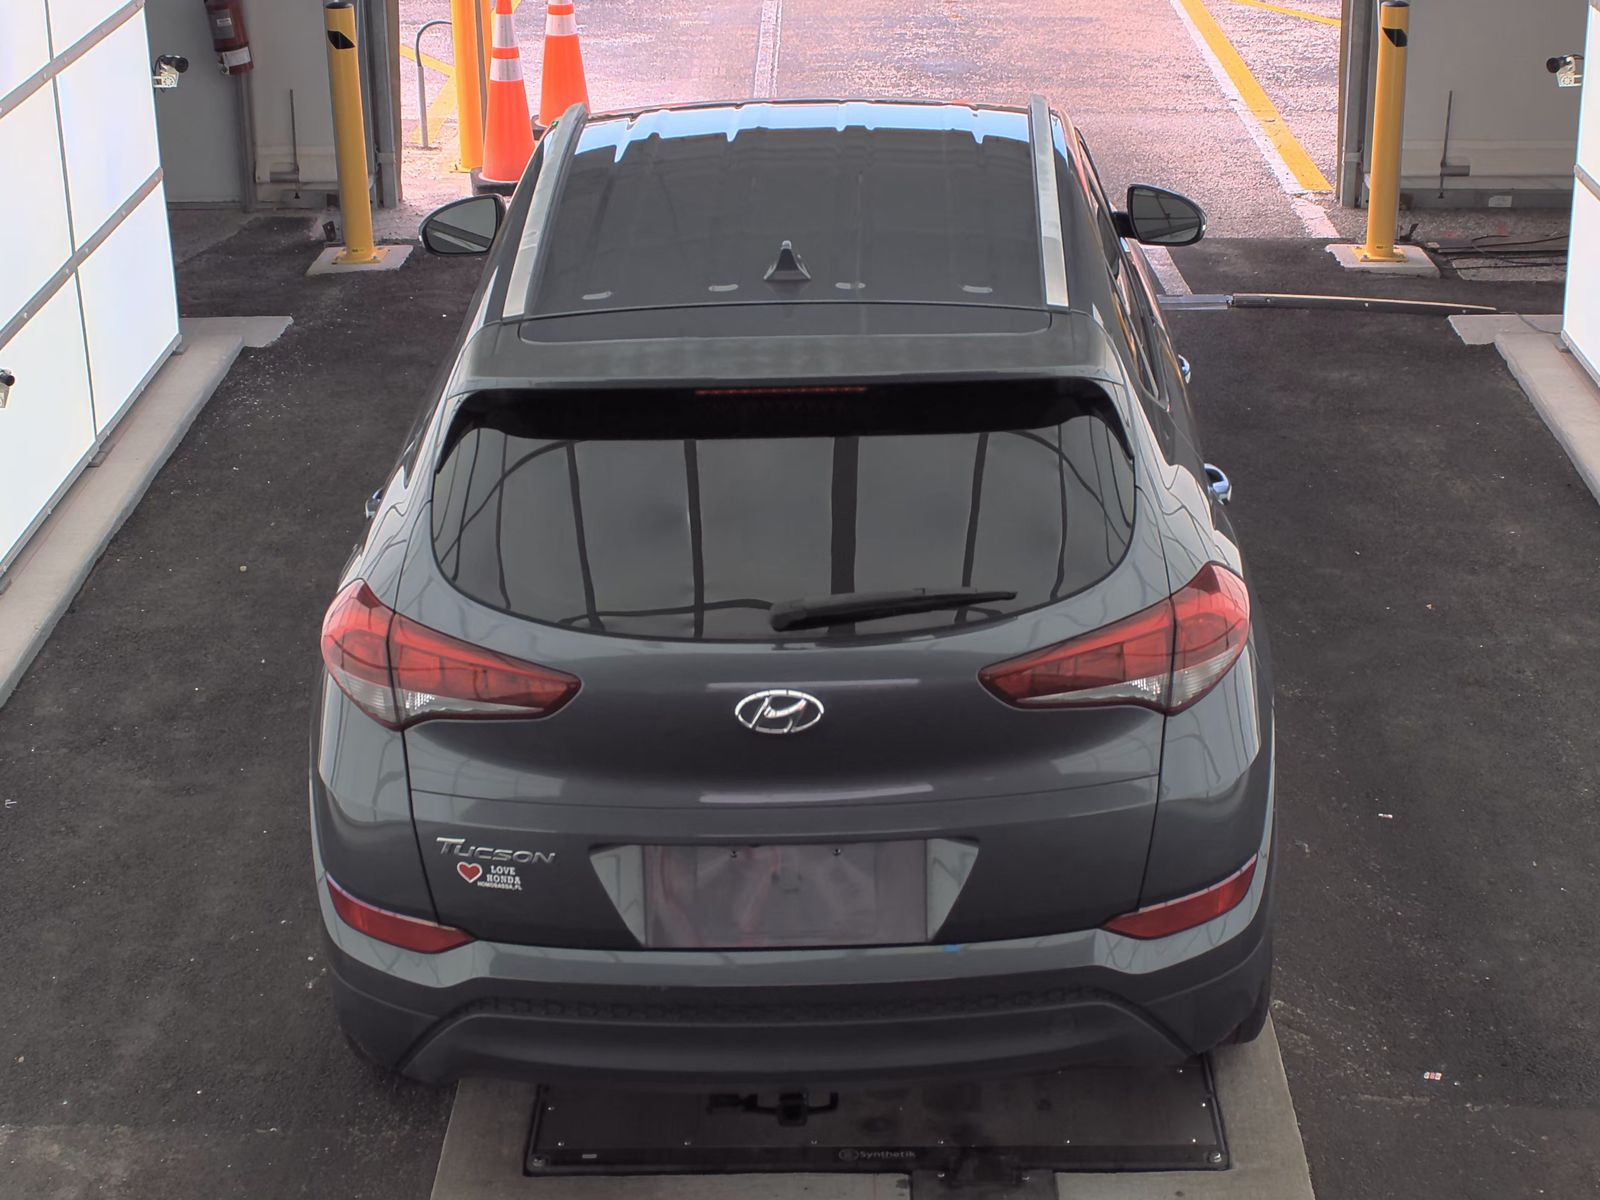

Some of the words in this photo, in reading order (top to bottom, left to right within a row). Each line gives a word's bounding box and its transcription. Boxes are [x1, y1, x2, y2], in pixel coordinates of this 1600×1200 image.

[436, 837, 556, 864] TUCSON
[490, 865, 516, 876] LOVE
[486, 874, 521, 885] HONDA
